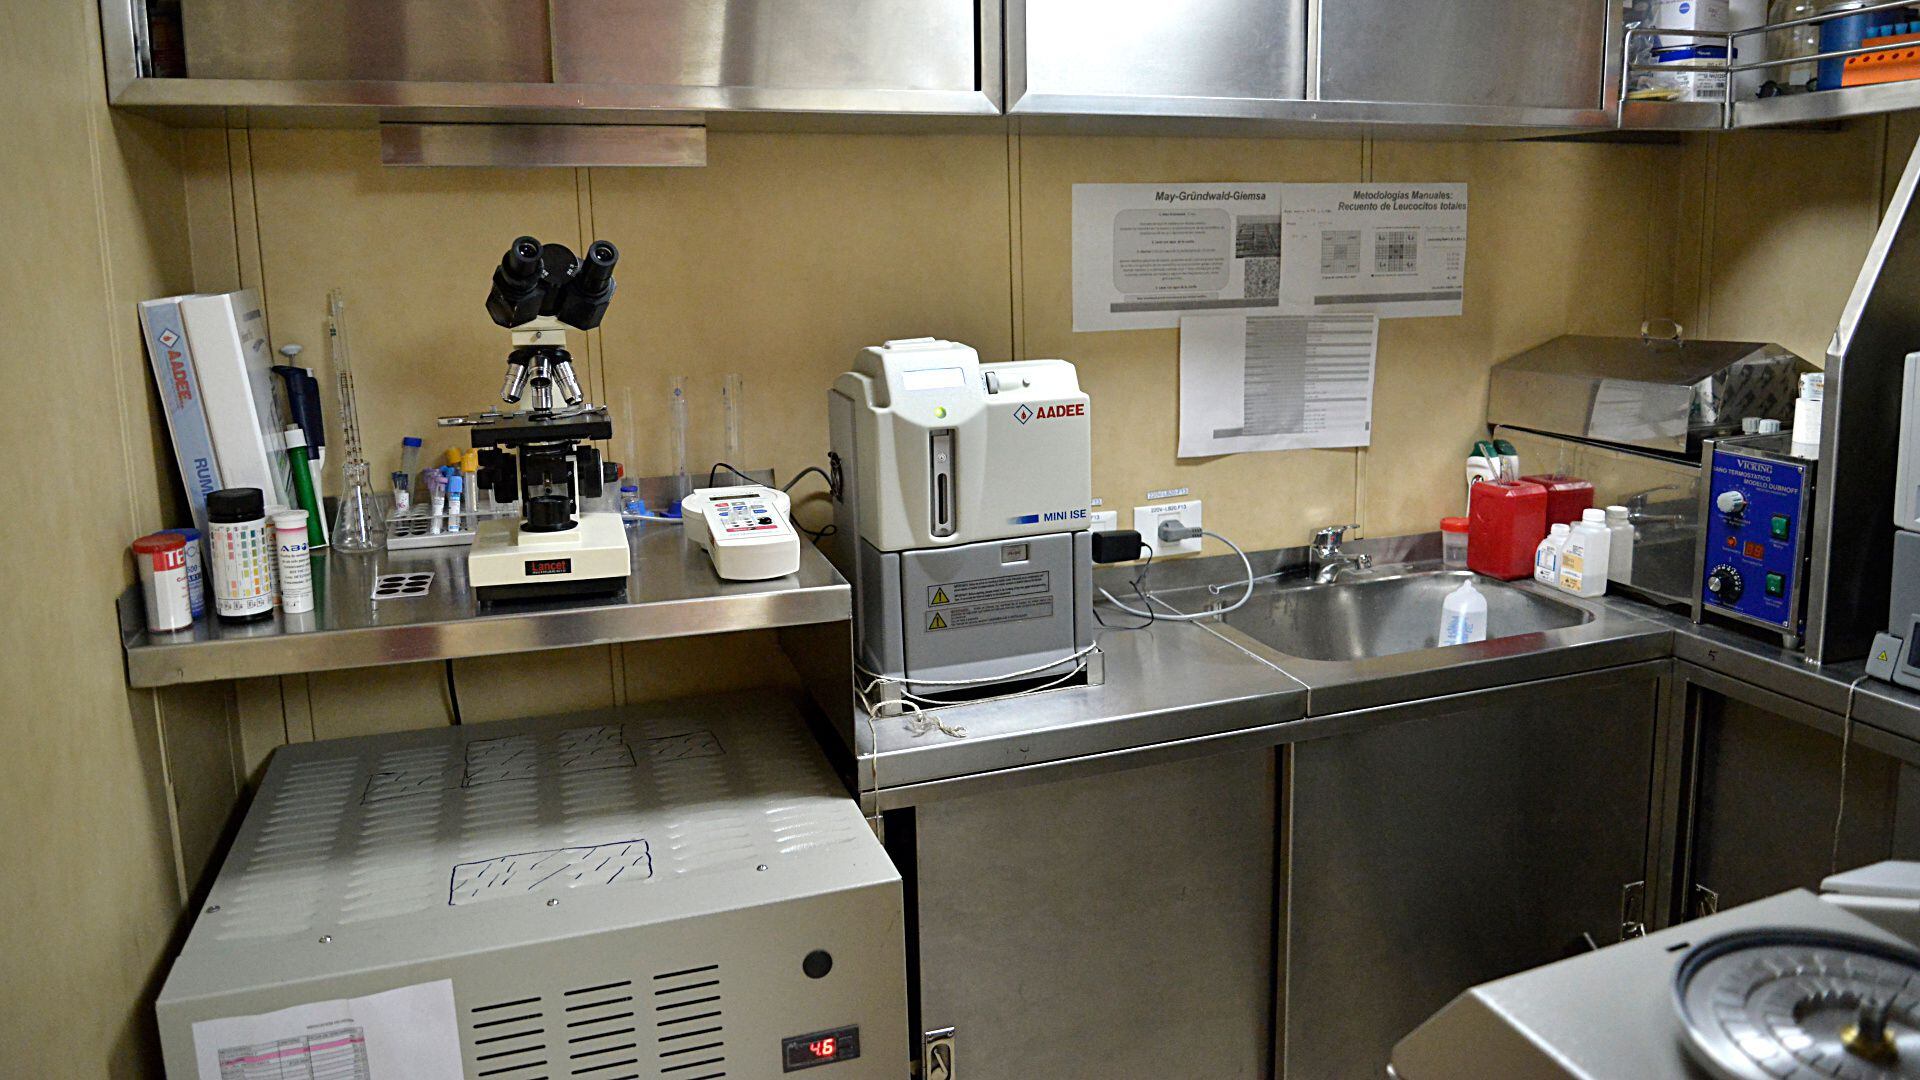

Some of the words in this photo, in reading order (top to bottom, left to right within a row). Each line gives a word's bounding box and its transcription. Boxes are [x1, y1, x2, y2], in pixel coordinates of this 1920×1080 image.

[1412, 191, 1454, 201] Manuales:
[1337, 201, 1379, 212] Recuento
[1380, 201, 1391, 211] de
[1393, 201, 1438, 212] Leucocitos
[1440, 201, 1467, 211] totales
[166, 350, 193, 403] AADEE
[1036, 403, 1085, 420] AADEE
[193, 457, 214, 497] RUM
[1043, 512, 1067, 522] MINI
[1070, 508, 1087, 519] ISE
[532, 560, 566, 571] Lancet
